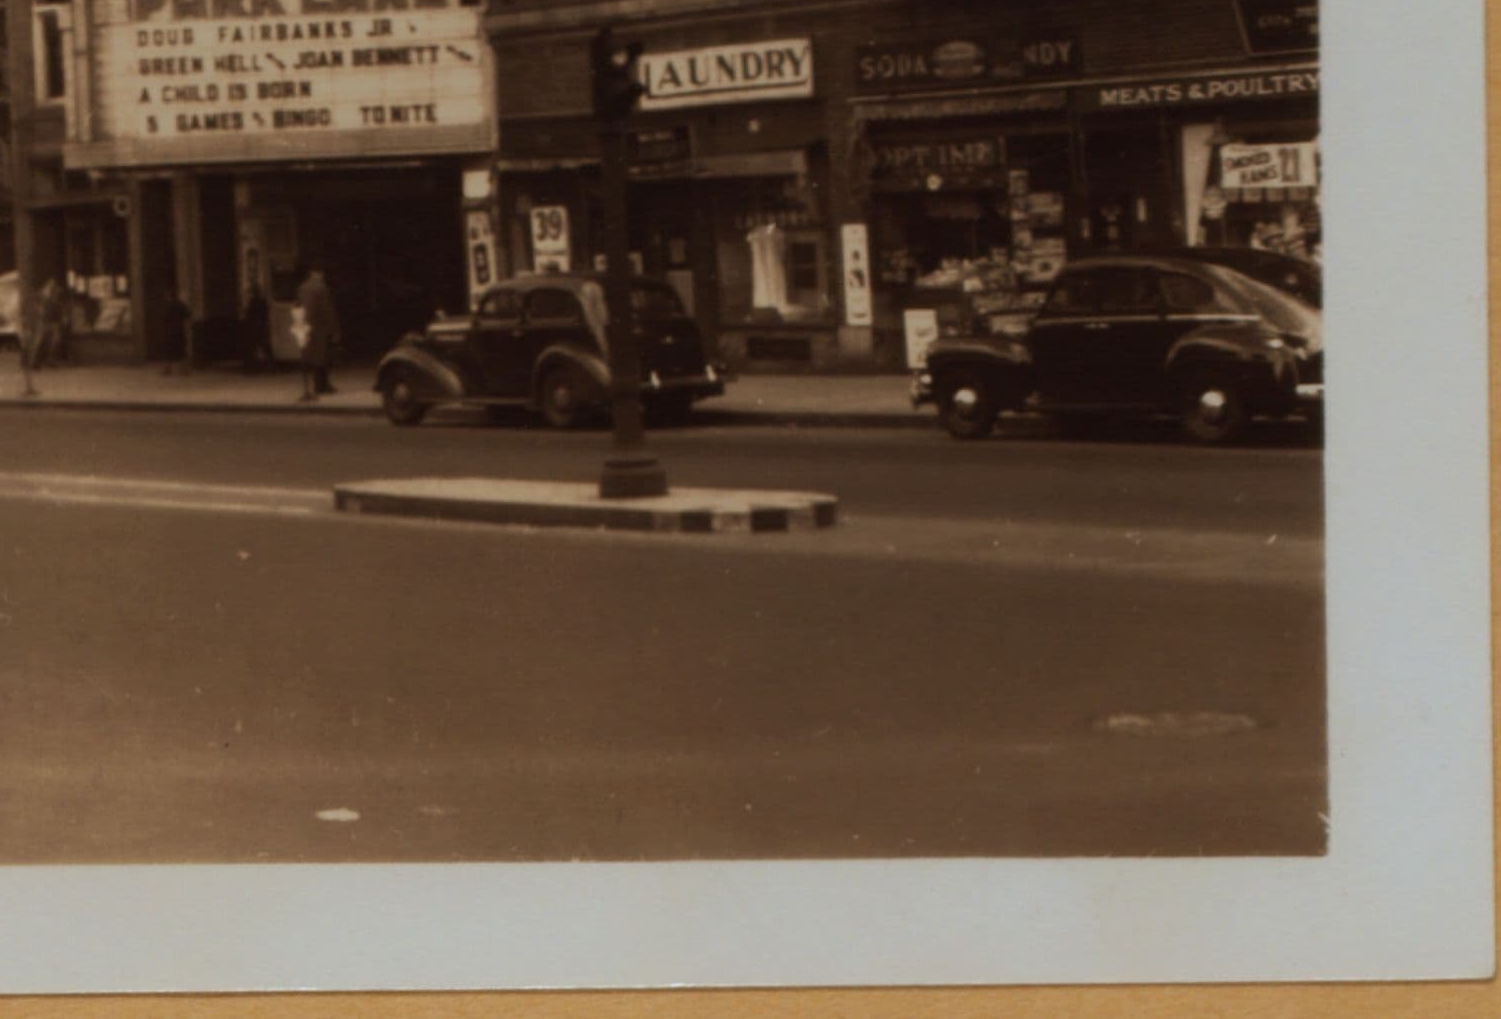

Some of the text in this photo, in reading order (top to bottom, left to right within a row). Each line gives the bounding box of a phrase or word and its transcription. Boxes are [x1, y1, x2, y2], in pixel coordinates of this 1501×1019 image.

[137, 18, 393, 47] DOUG FAIRBANKS JR
[138, 45, 439, 76] GREEN HELL JOAN BENNETT
[645, 48, 810, 97] LAUNDRY
[859, 54, 929, 81] SODA
[139, 81, 312, 103] A CHILD IS BORN
[1099, 72, 1320, 107] MEATS & POULTRY
[175, 112, 244, 132] GAMES
[273, 108, 332, 129] BINGO
[534, 210, 563, 241] 39
